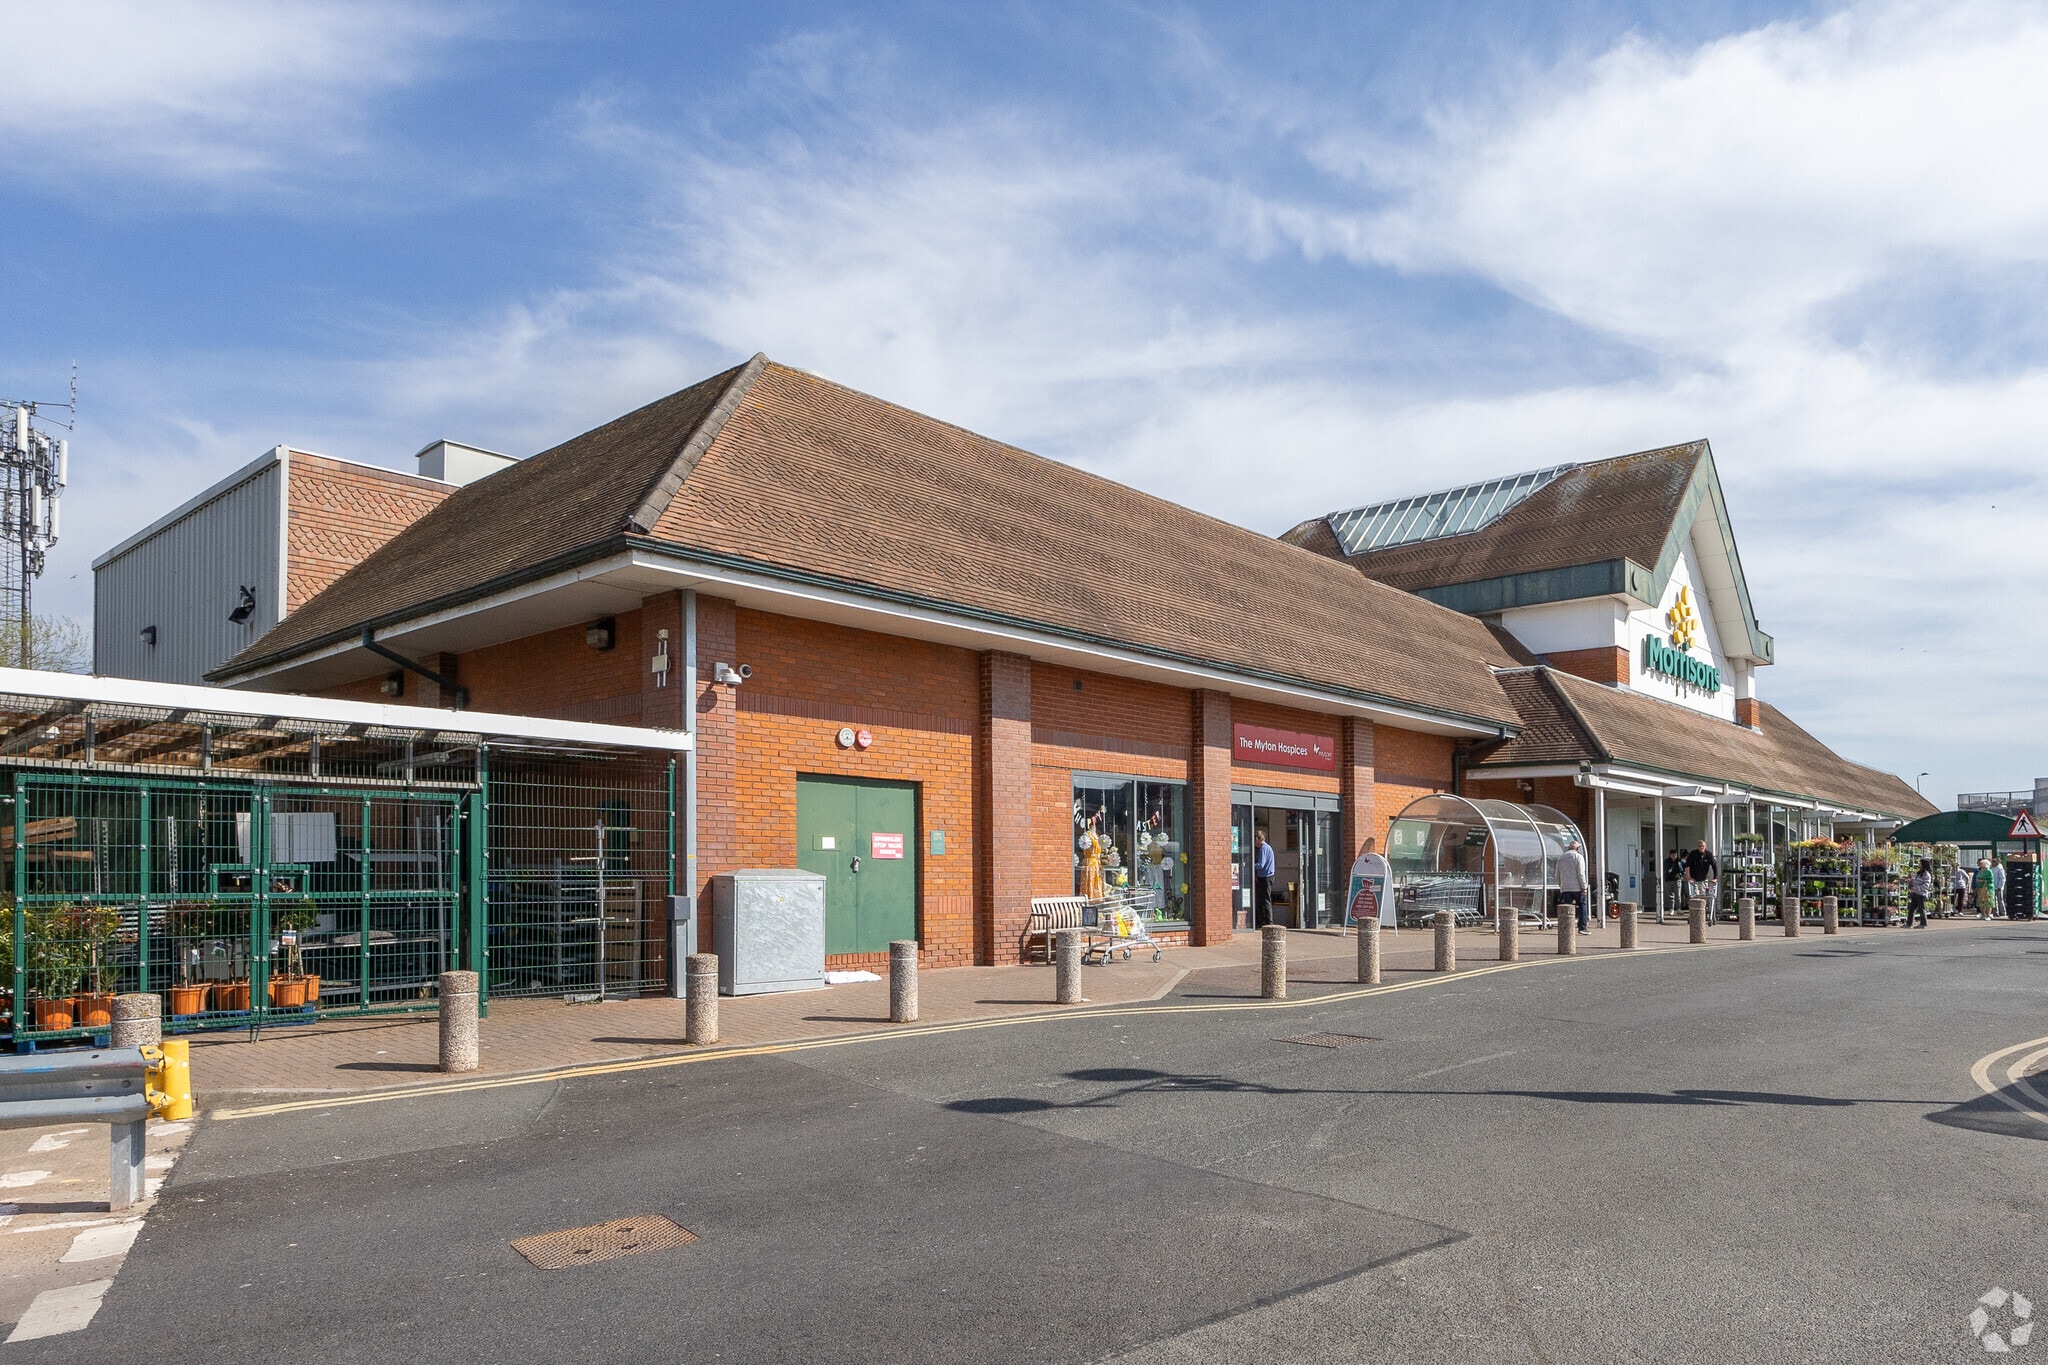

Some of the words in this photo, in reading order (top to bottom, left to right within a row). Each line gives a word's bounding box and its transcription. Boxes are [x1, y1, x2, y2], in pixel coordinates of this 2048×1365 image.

[1645, 634, 1721, 692] Morrisons
[1239, 737, 1253, 749] The
[1254, 739, 1277, 752] Myton
[1278, 742, 1308, 756] Hospices
